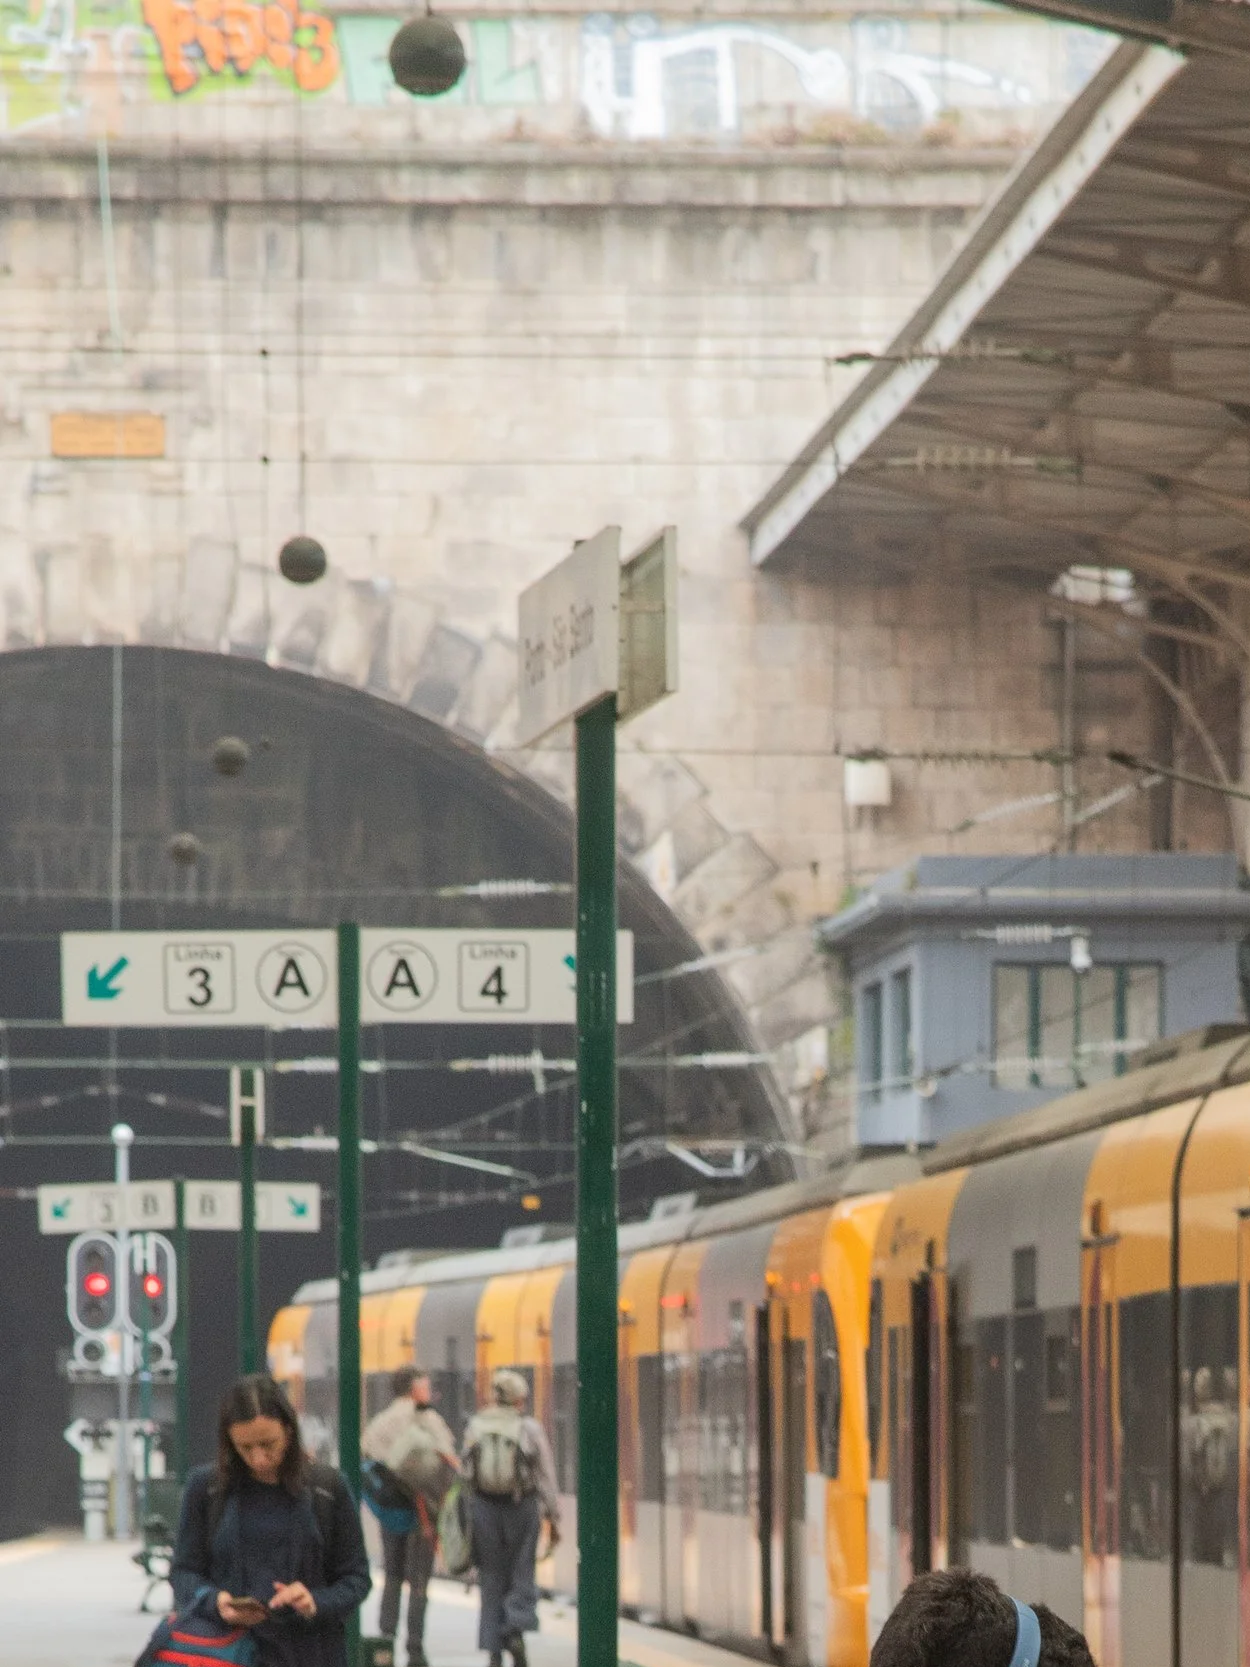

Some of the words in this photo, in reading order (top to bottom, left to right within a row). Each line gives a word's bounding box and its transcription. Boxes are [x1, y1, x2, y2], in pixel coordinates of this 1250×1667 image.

[187, 966, 213, 1007] 3
[273, 957, 310, 997] A
[384, 957, 421, 997] A
[480, 965, 508, 1004] 4
[231, 1065, 265, 1146] H
